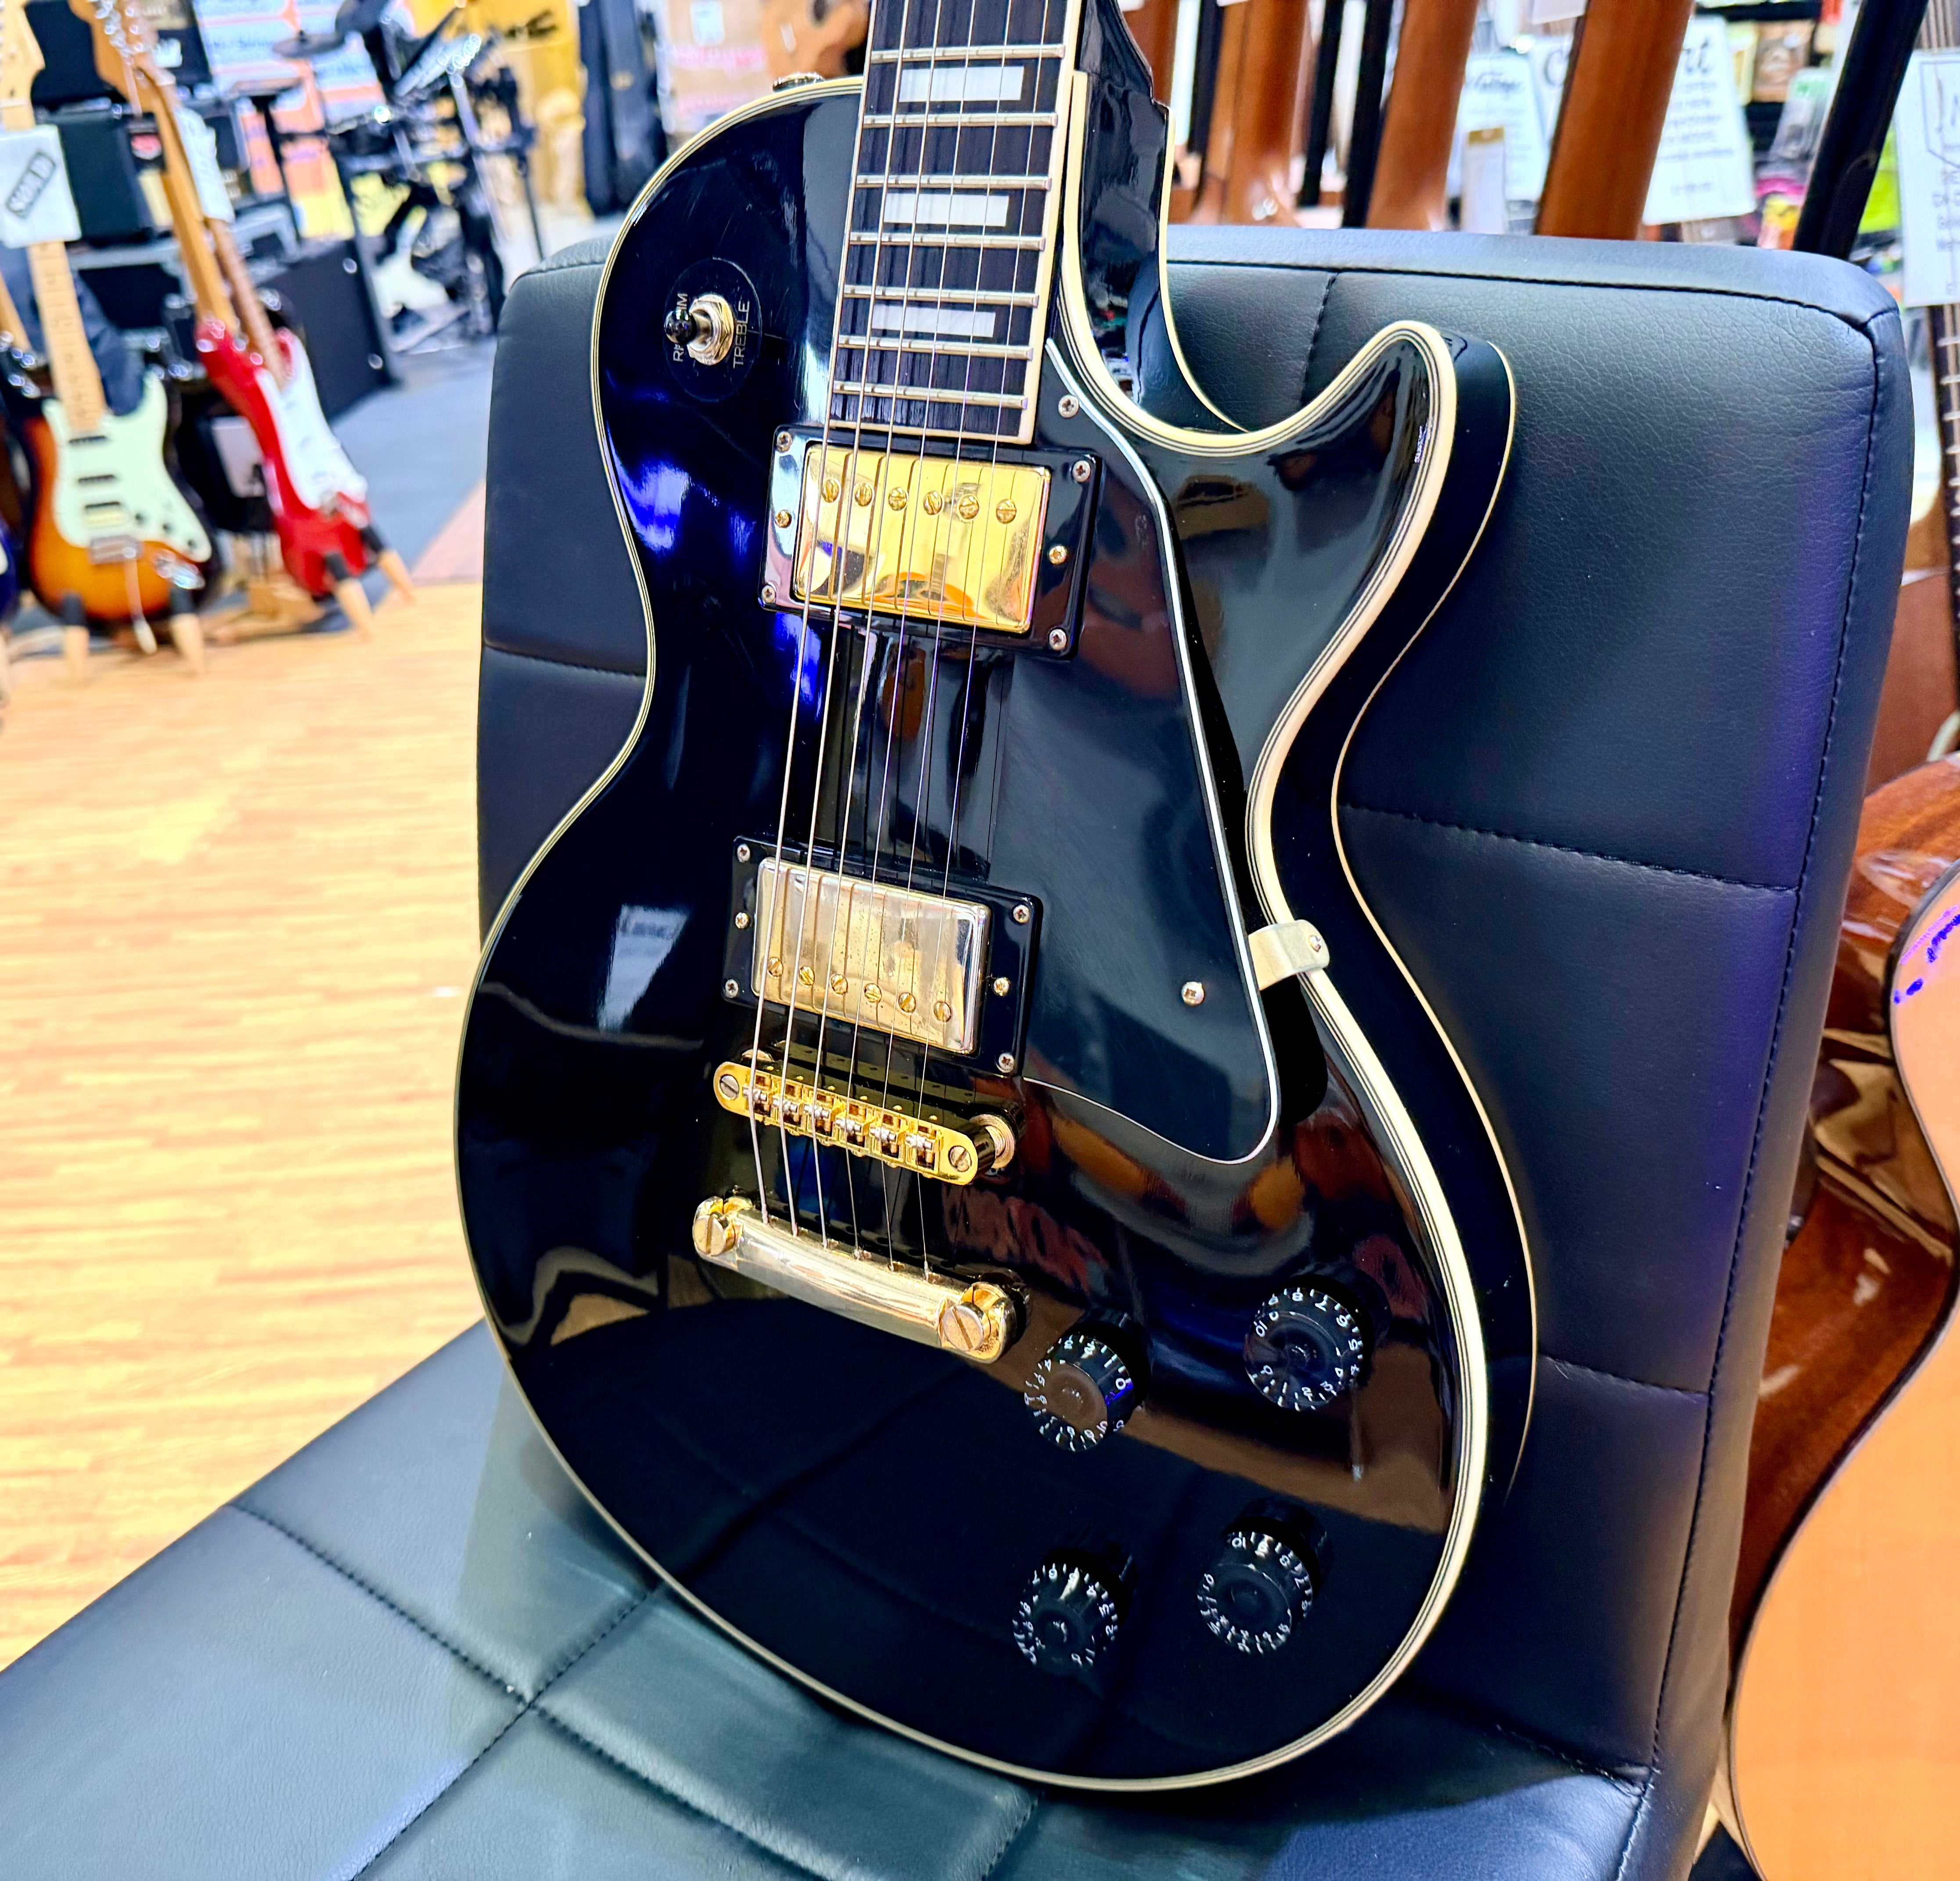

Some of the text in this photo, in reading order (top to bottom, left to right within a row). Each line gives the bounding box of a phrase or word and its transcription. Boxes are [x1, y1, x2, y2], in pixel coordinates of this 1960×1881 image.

[733, 300, 750, 369] TREBLE
[1336, 1315, 1349, 1328] 6
[1348, 1339, 1358, 1351] 5
[1115, 1377, 1126, 1390] 0
